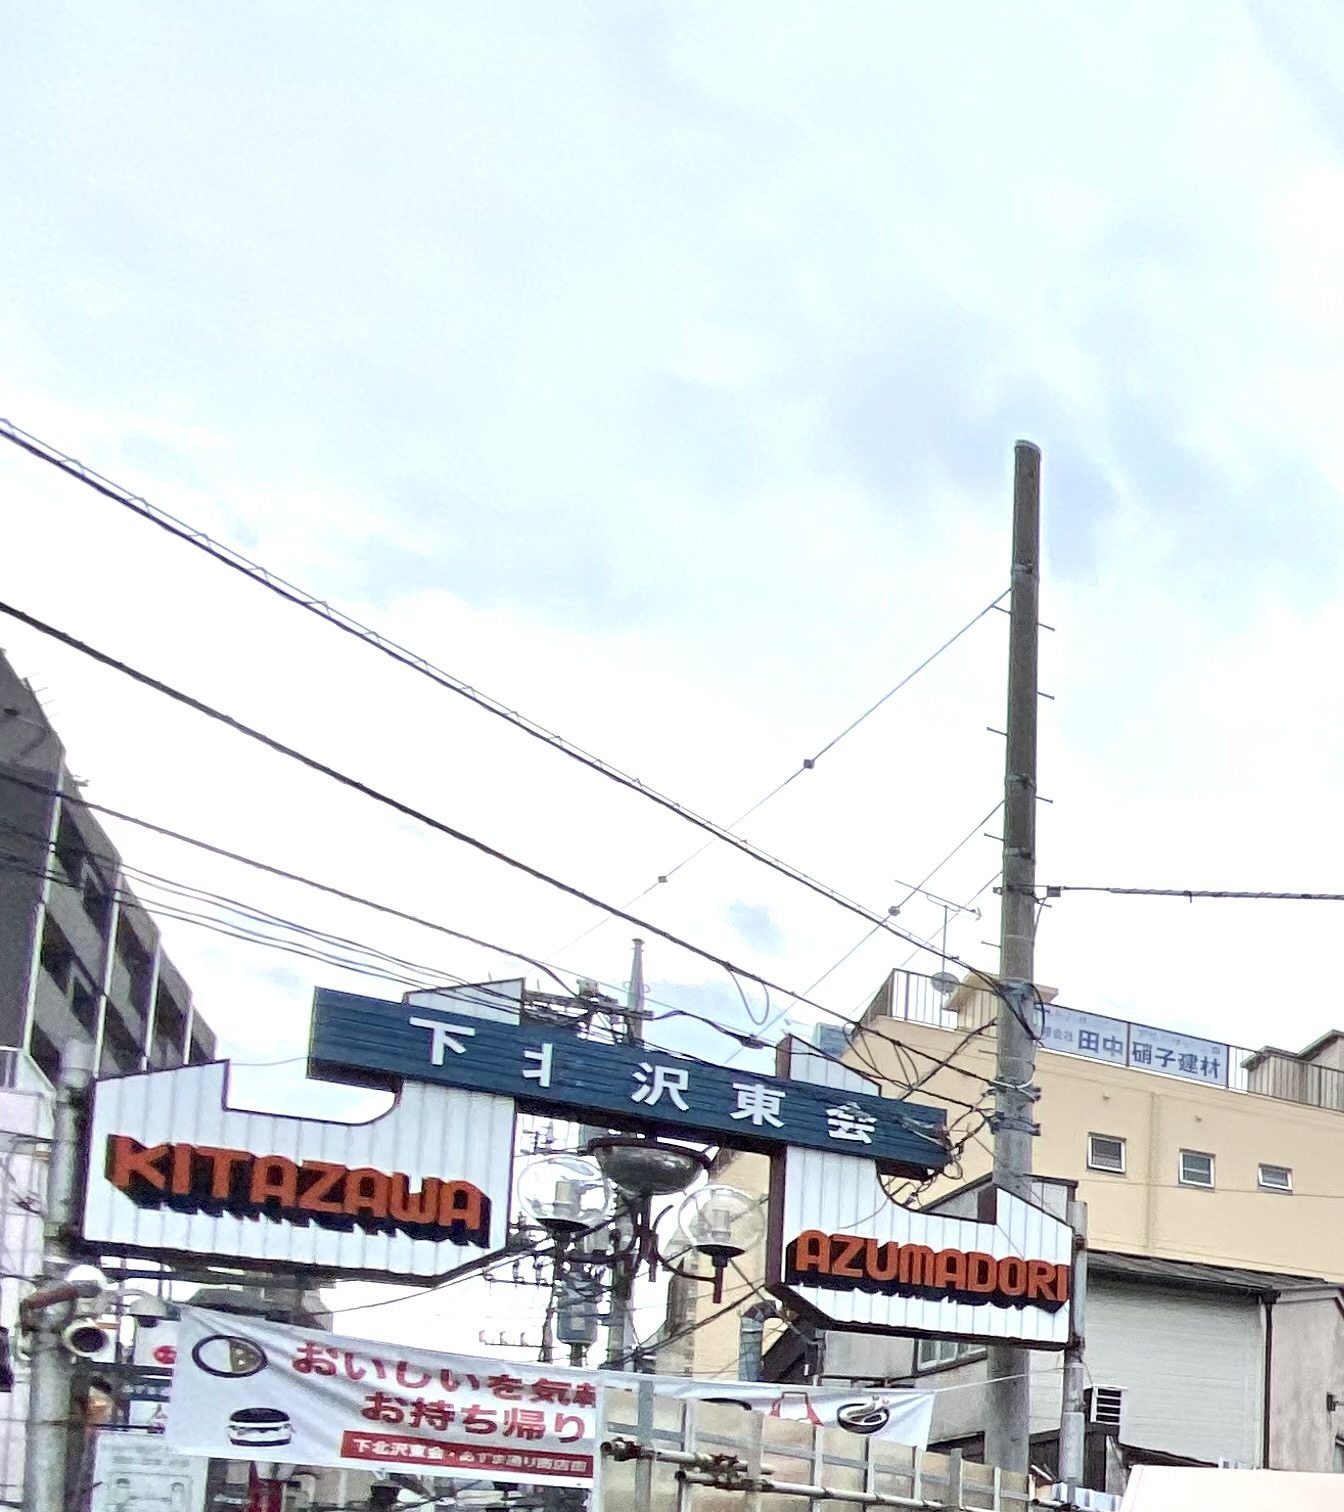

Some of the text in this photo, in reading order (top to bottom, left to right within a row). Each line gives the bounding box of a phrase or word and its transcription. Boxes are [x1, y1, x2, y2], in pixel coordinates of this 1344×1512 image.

[108, 1134, 490, 1242] KITAZAWA
[790, 1230, 1069, 1308] AZUMADORI
[361, 1392, 586, 1443] お持ち帰り
